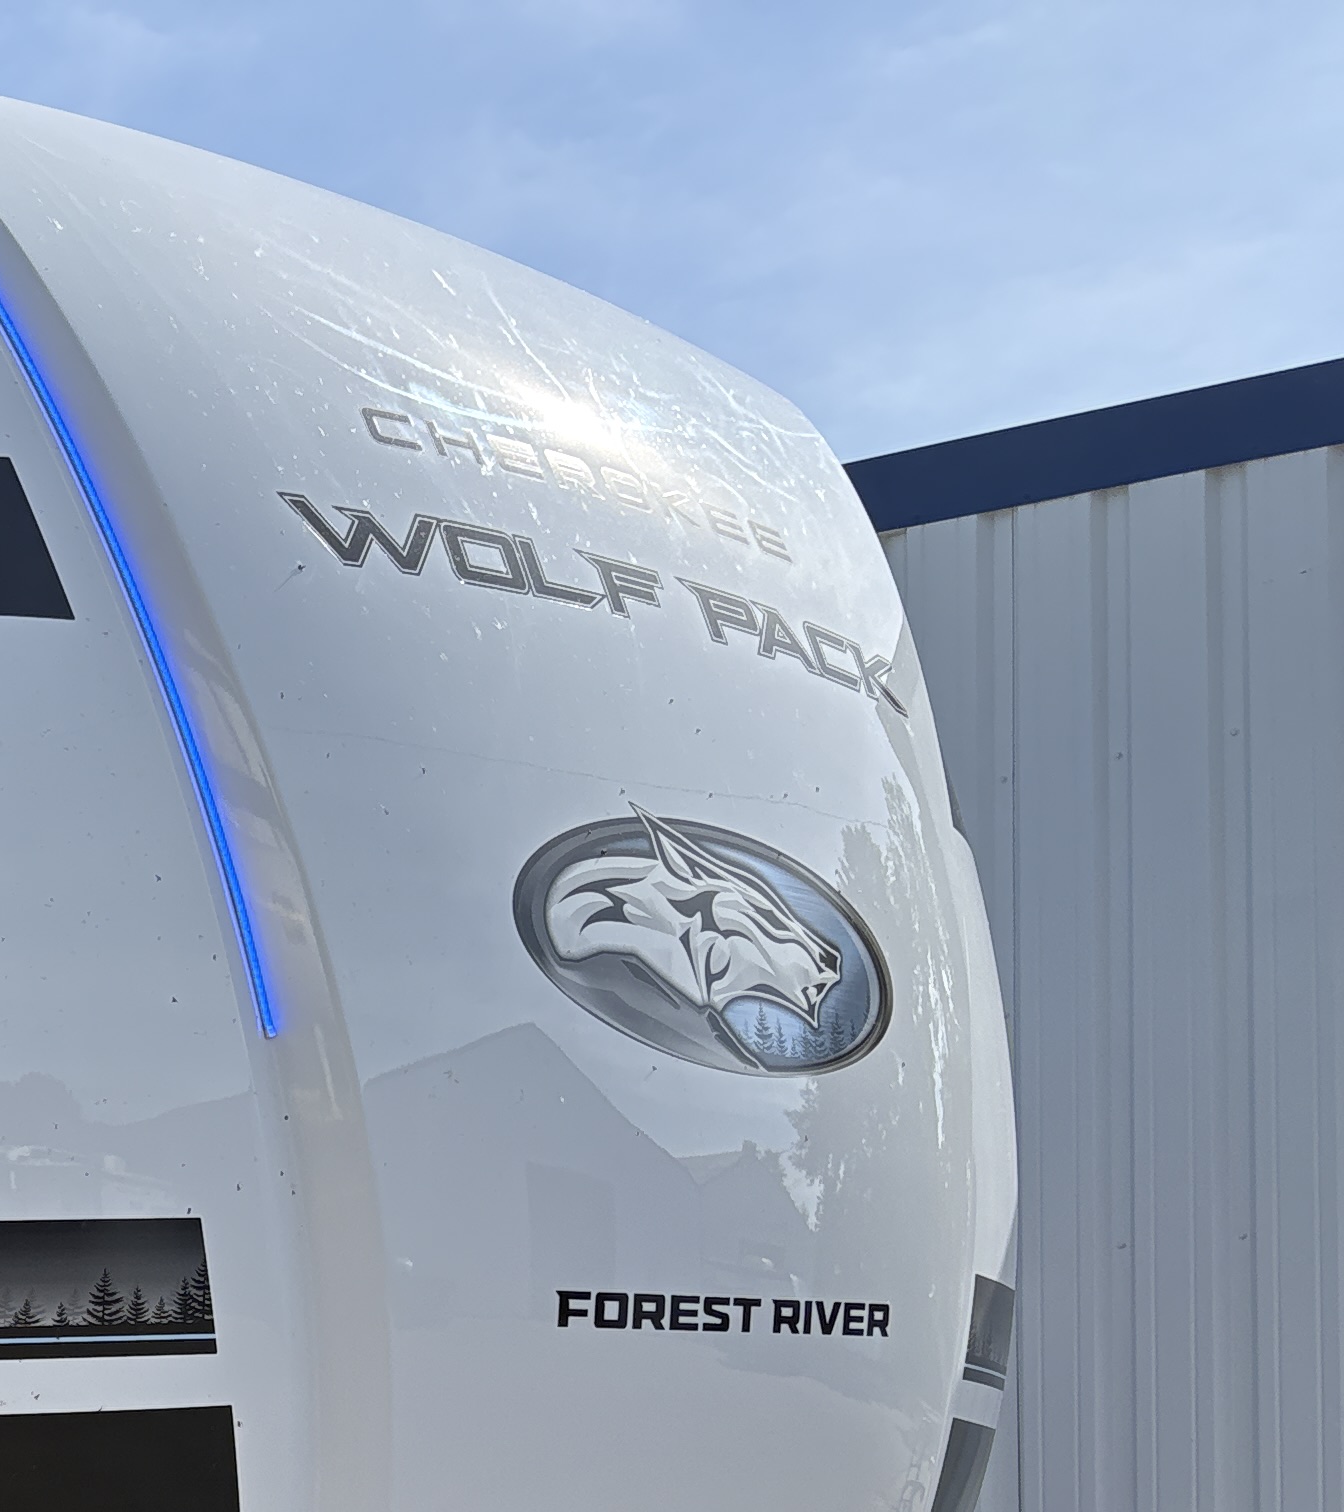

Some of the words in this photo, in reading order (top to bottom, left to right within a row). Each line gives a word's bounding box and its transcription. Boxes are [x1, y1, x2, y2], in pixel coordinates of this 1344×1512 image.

[361, 406, 794, 564] CHEROKEE
[276, 490, 664, 620] WOLF
[675, 575, 910, 719] PACK
[555, 1289, 762, 1333] FOREST
[771, 1298, 890, 1337] RIVER
